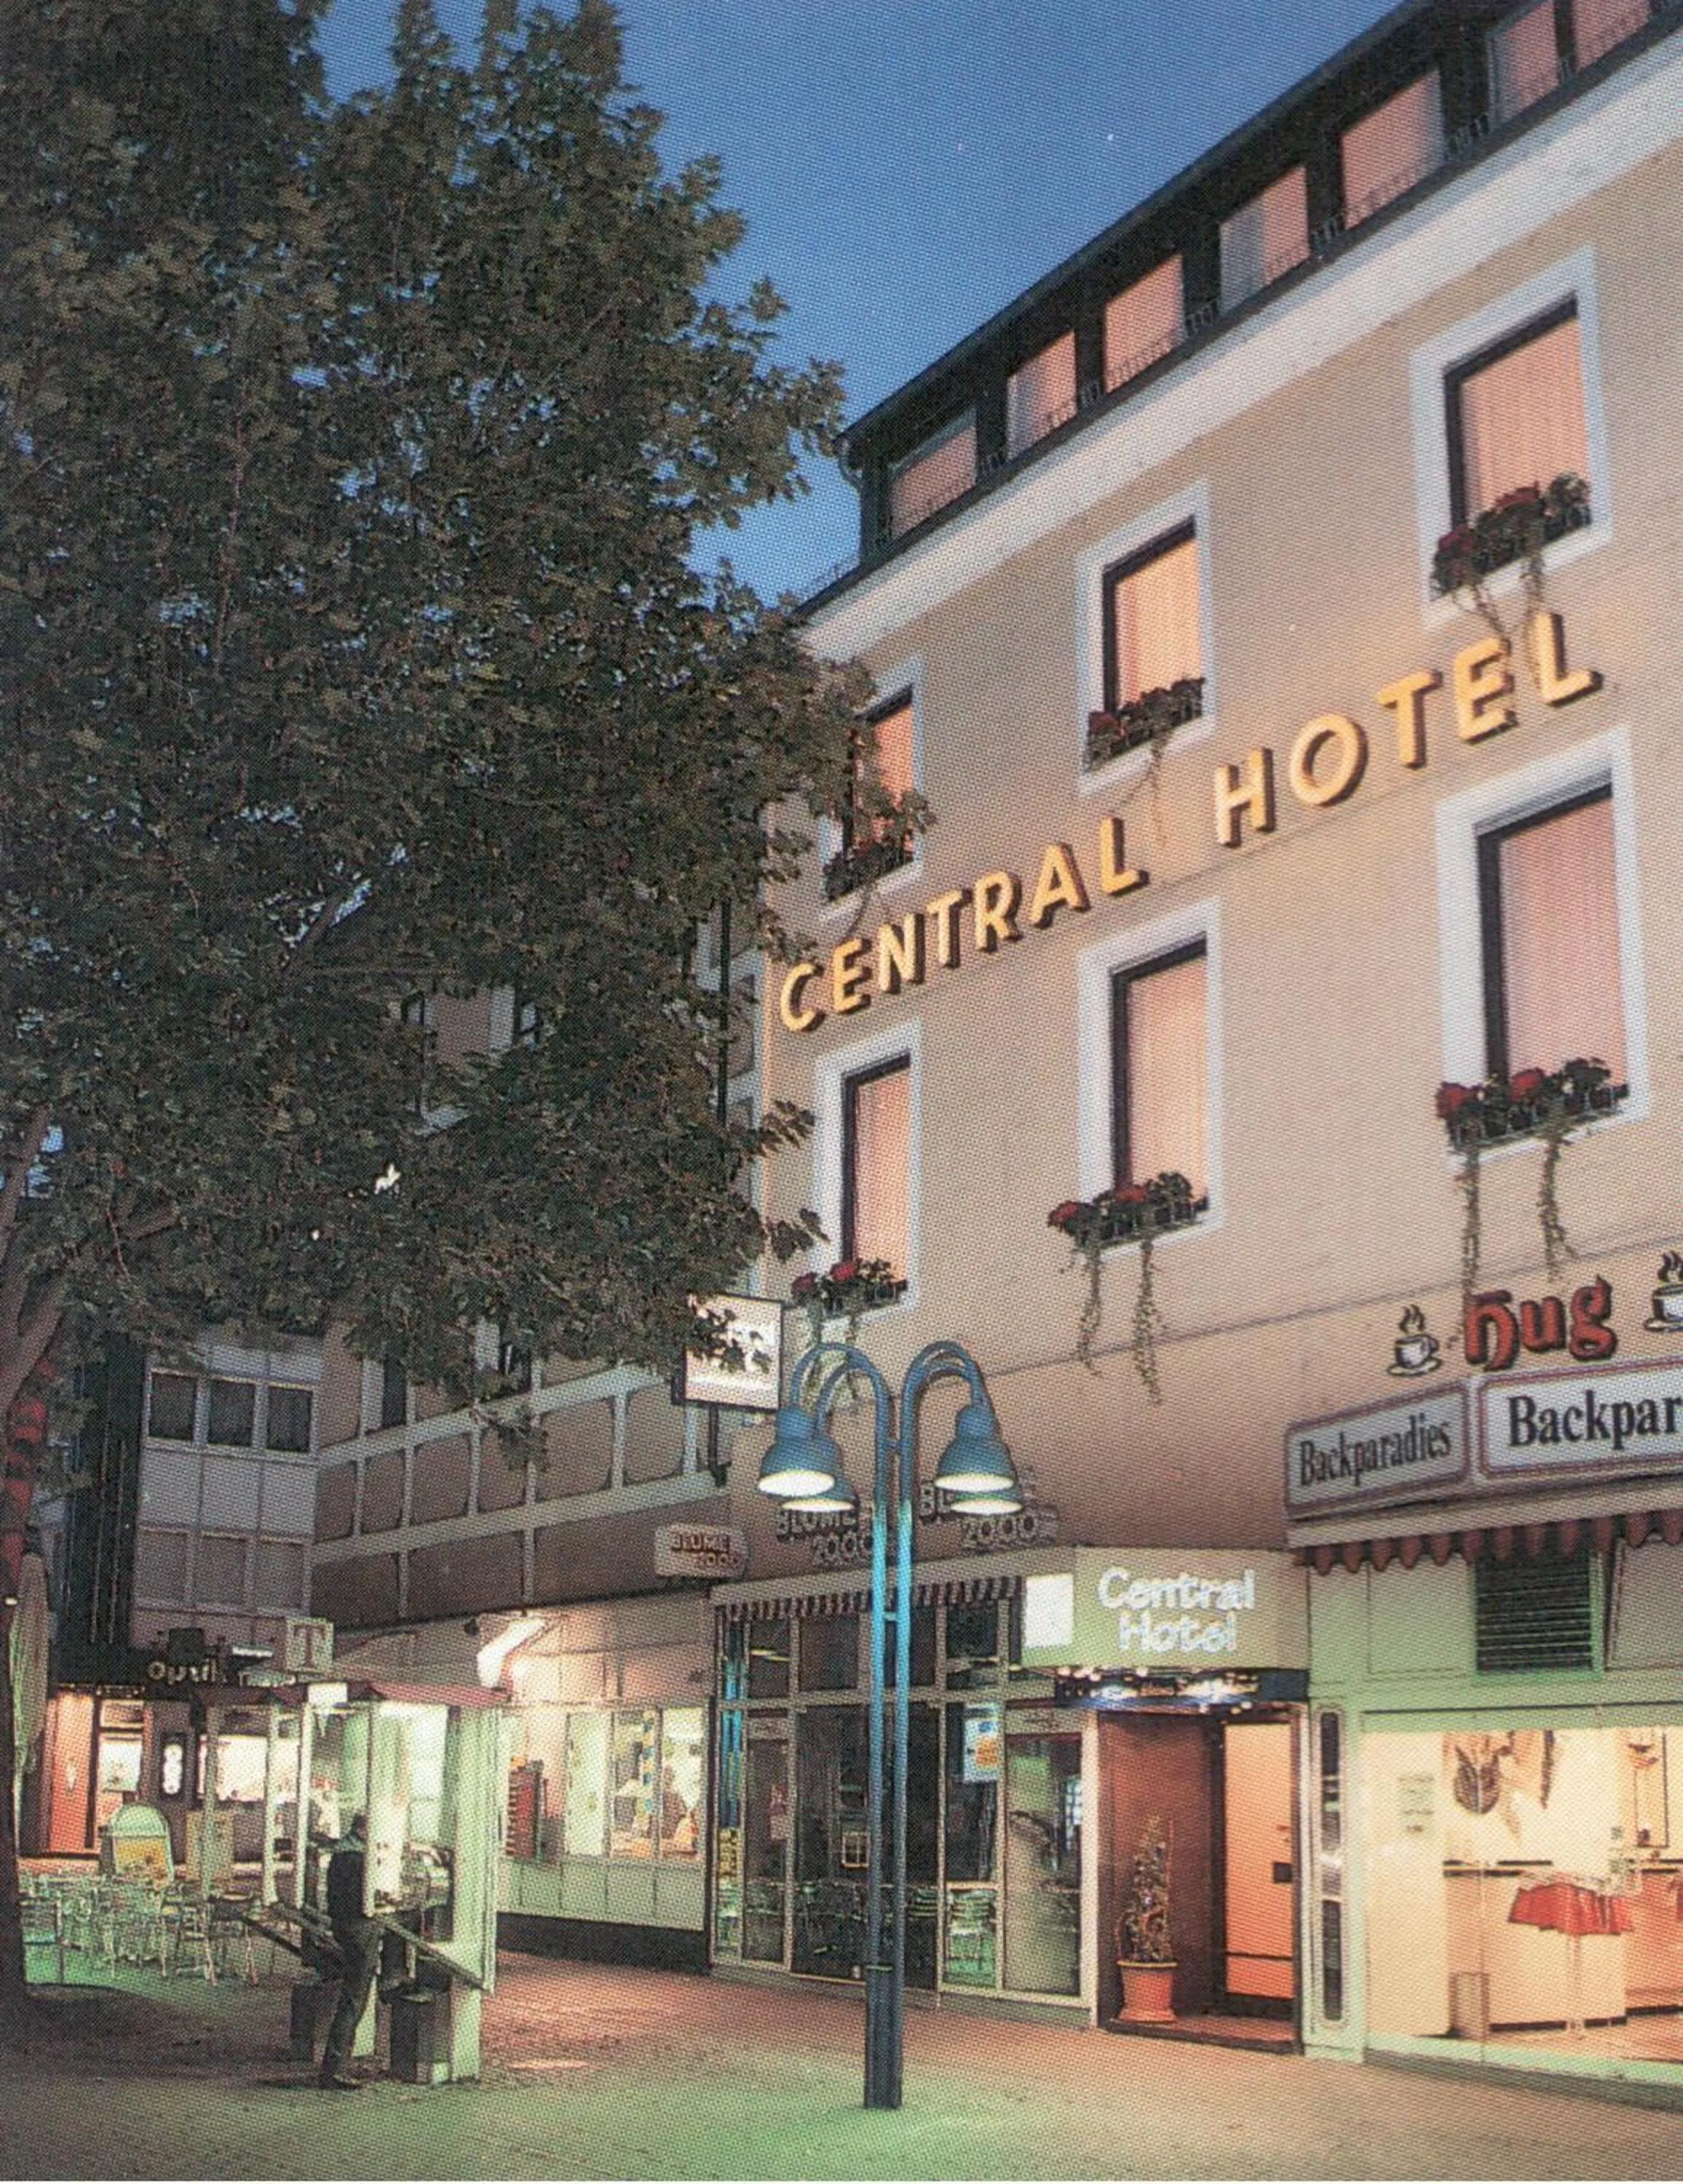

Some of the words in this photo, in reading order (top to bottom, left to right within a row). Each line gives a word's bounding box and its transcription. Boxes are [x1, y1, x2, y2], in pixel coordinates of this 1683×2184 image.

[779, 814, 1149, 1032] CENTRAL
[1213, 612, 1603, 847] HOTEL
[1299, 1412, 1452, 1487] Backparadies
[962, 1508, 1040, 1549] 2000
[1097, 1566, 1256, 1611] Central
[1118, 1610, 1237, 1654] Hotel
